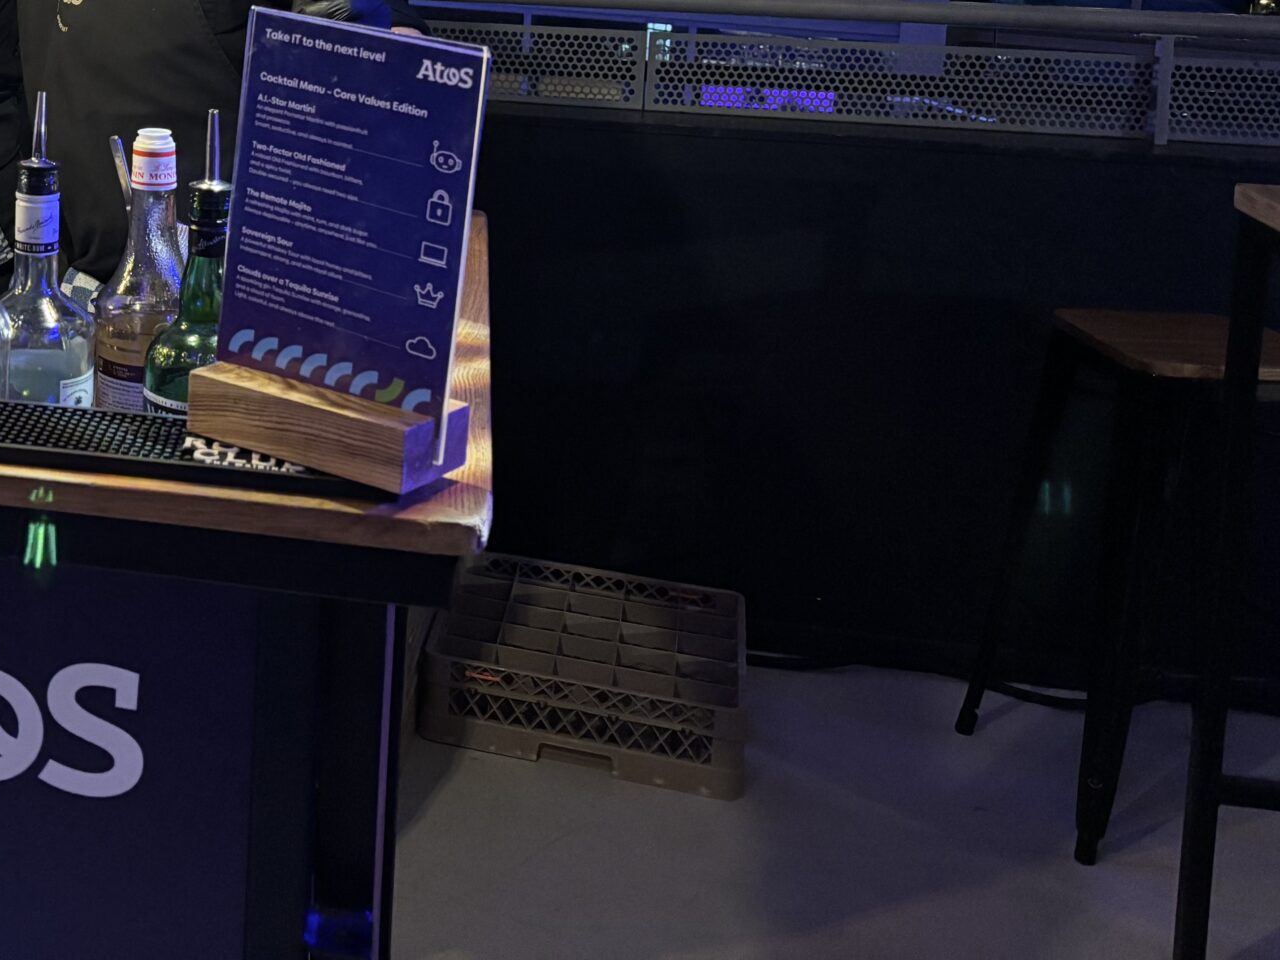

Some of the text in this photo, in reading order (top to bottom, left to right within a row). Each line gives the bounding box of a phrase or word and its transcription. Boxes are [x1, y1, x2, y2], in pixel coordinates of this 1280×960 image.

[265, 28, 386, 63] Take IT to the next level
[416, 58, 474, 88] Atos
[260, 71, 299, 90] Cocktail
[300, 80, 325, 95] Menu
[333, 88, 356, 102] Core
[358, 93, 391, 110] Values
[392, 100, 428, 118] Edition
[288, 100, 316, 114] Martini
[252, 140, 346, 172] Two-Factor Old Fashioned
[246, 187, 312, 213] The Remote Mojito
[242, 226, 276, 243] Sovereign
[277, 236, 293, 248] Sour
[237, 264, 262, 278] Clouds
[262, 272, 278, 284] over
[284, 278, 311, 294] Tequila
[312, 287, 339, 303] Sunrise
